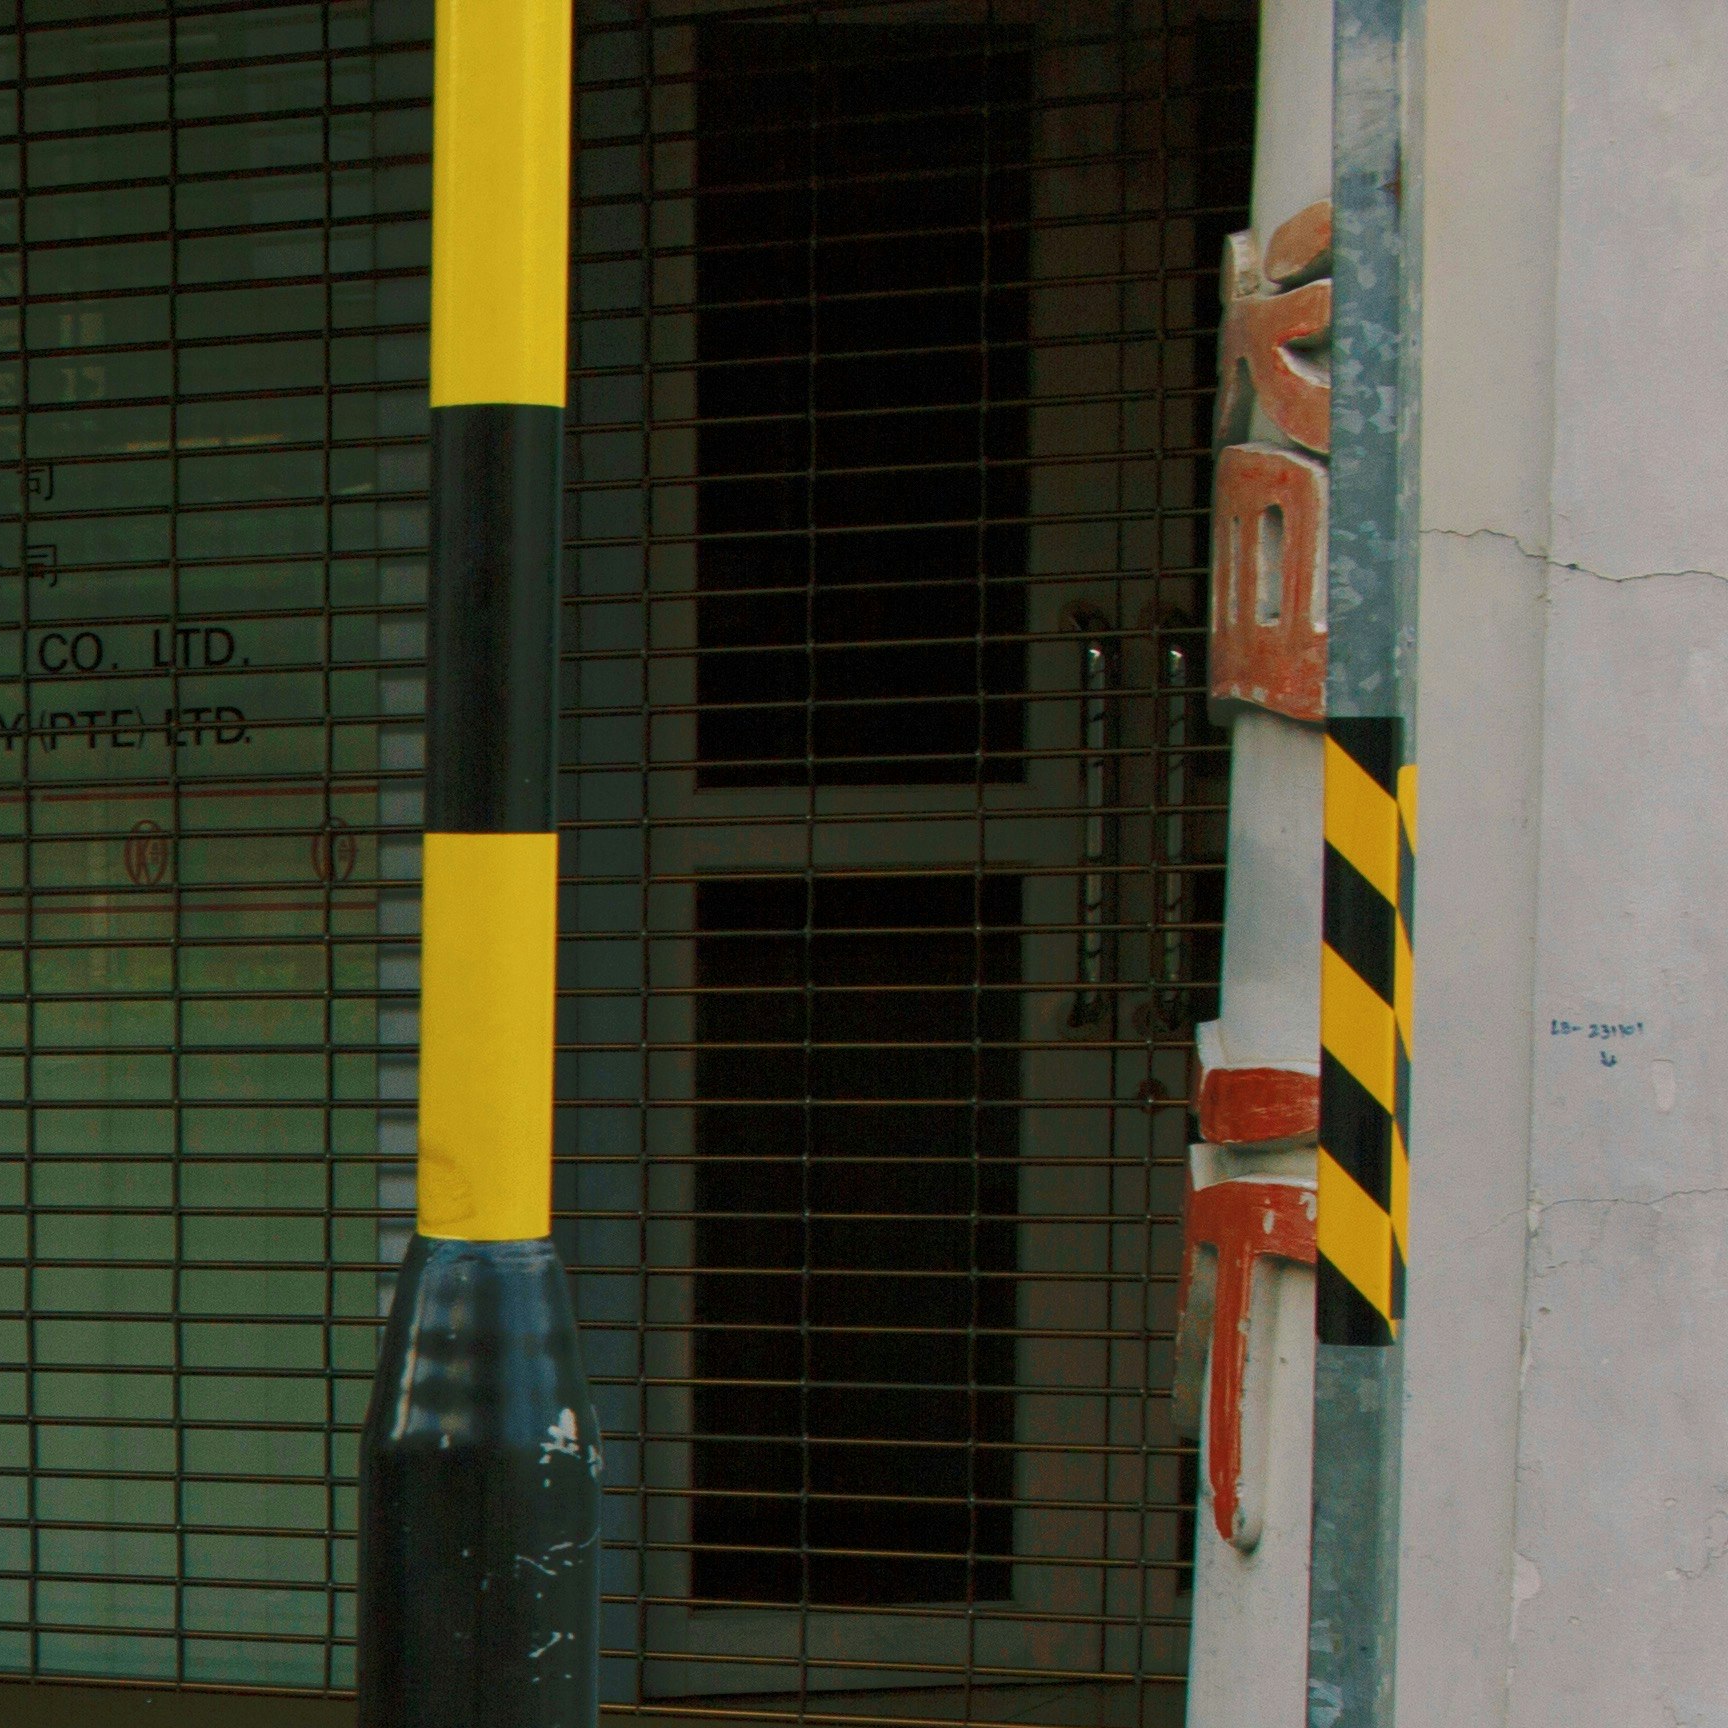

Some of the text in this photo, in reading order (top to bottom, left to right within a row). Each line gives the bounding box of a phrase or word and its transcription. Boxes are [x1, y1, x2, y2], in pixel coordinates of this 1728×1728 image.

[38, 631, 119, 673] CO.
[153, 627, 250, 668] LTD.
[40, 705, 144, 752] (PTE)
[164, 706, 252, 747] LTD.
